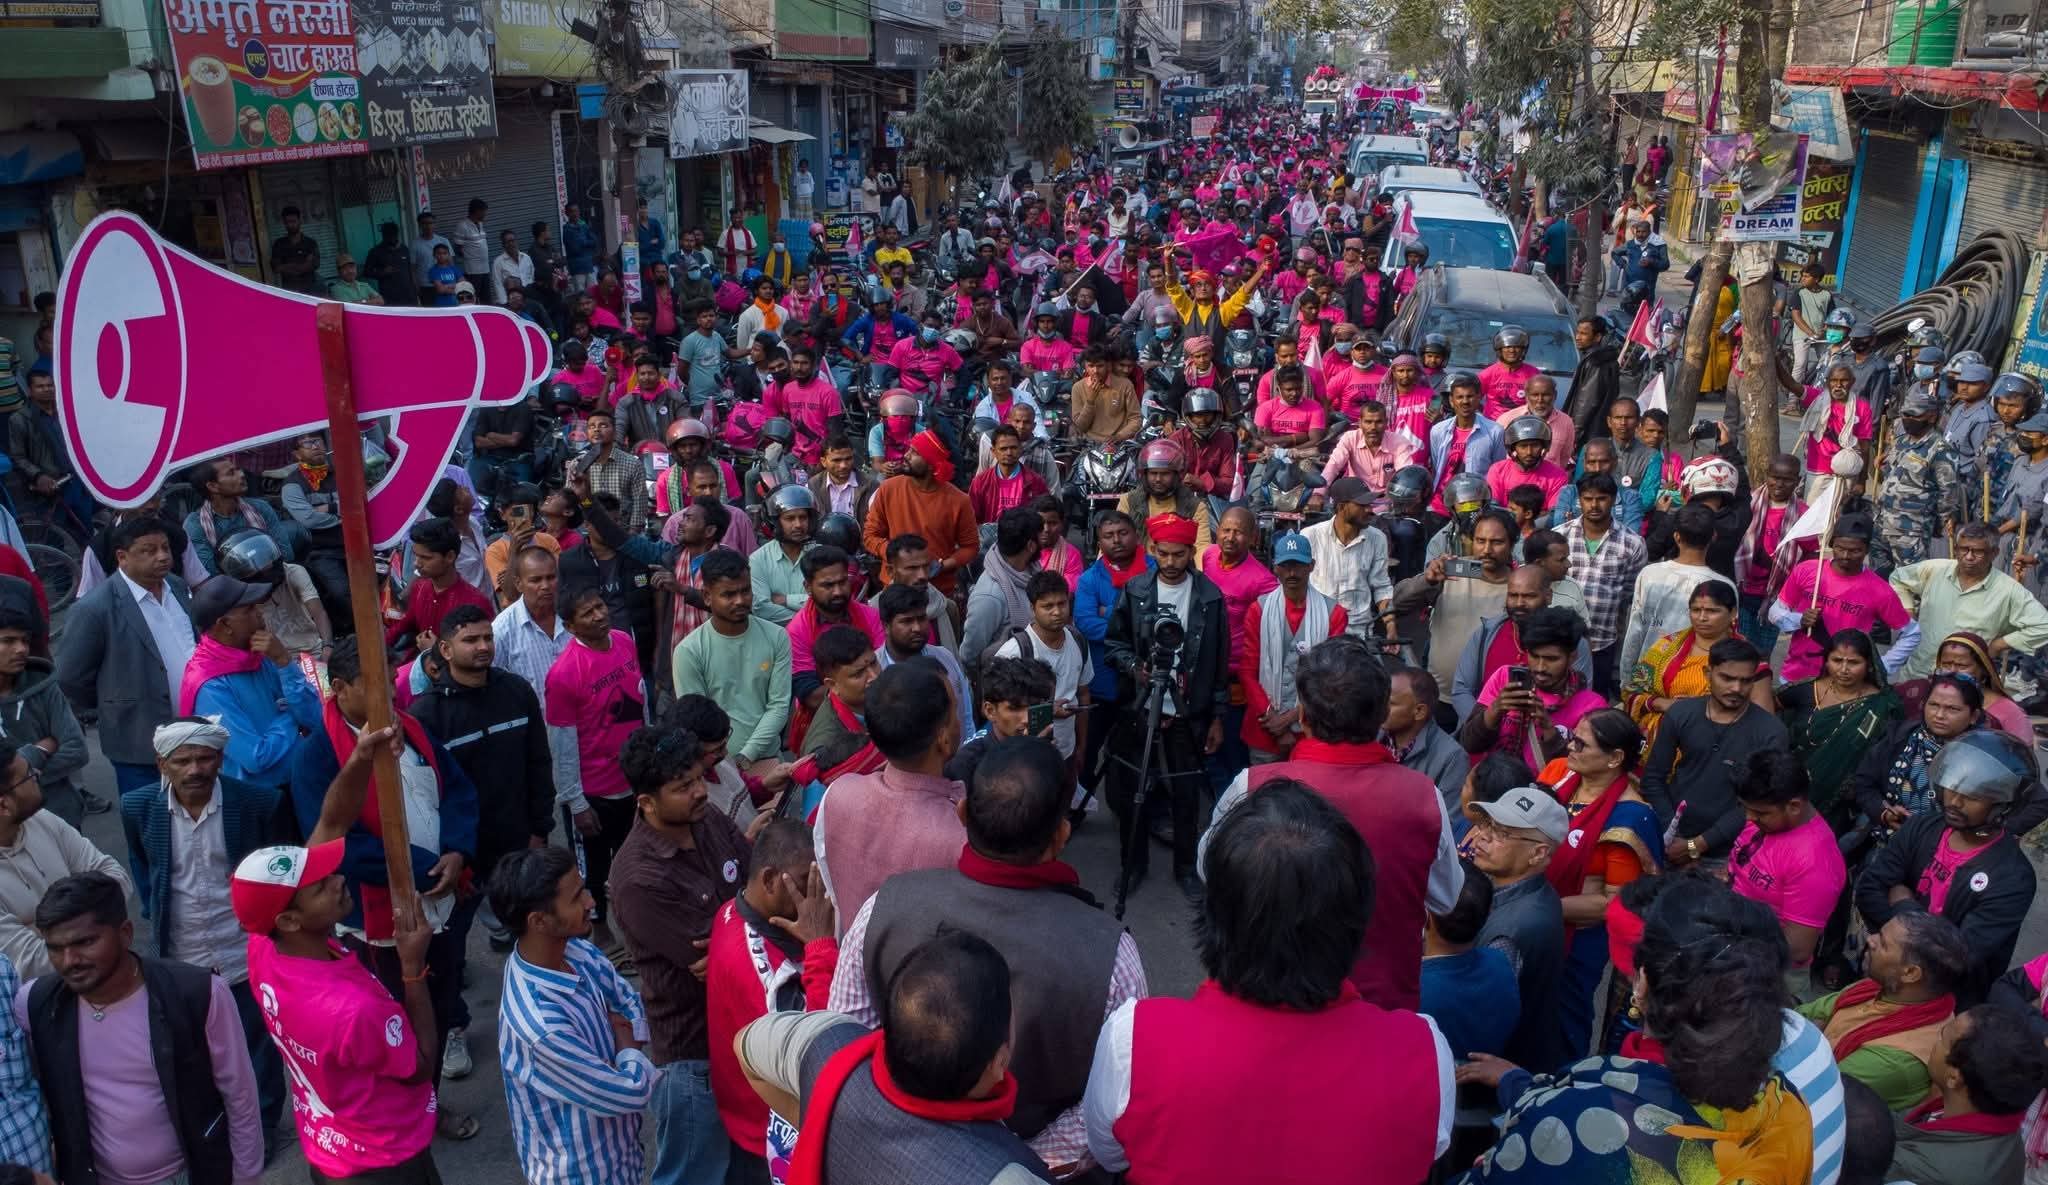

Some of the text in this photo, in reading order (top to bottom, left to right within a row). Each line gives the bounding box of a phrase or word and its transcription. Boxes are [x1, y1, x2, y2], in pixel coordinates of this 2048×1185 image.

[392, 16, 445, 27] VIDEO MIXING
[501, 0, 549, 27] SNEHA
[268, 44, 309, 72] चाट
[1735, 217, 1793, 229] DREAM
